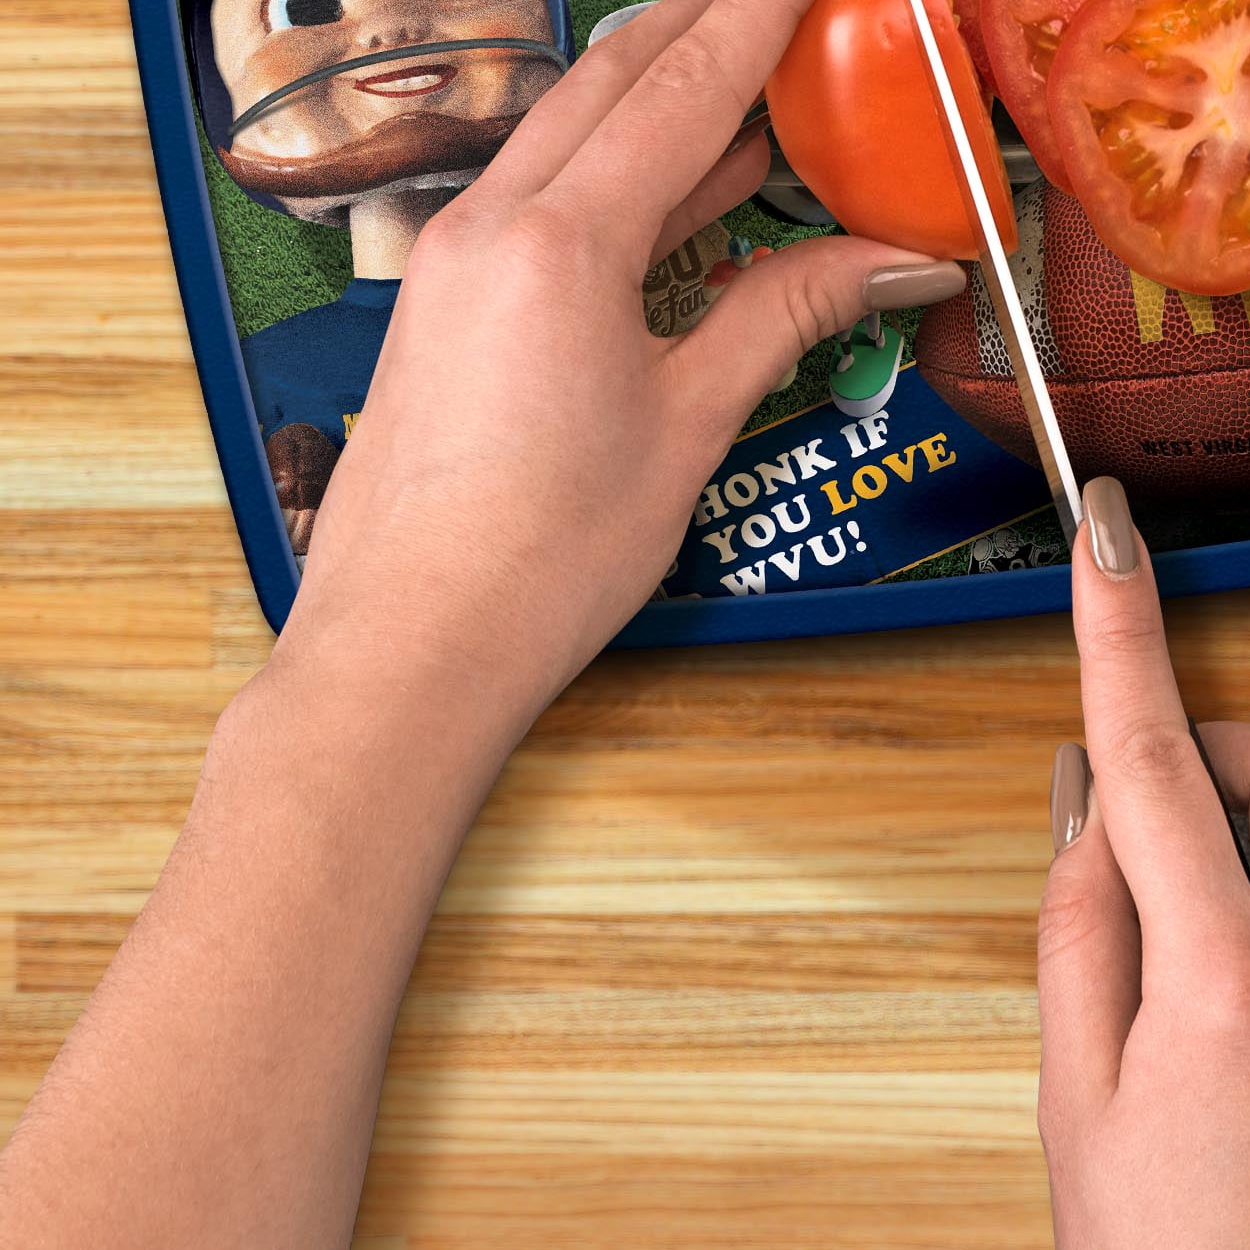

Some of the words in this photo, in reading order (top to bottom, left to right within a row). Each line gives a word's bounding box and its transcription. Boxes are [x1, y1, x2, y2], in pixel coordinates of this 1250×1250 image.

[695, 438, 837, 526] HONK
[840, 409, 889, 458] IF
[1139, 440, 1193, 457] WEST
[702, 494, 811, 564] YOU
[820, 432, 957, 515] LOVE
[720, 520, 867, 596] WVU!
